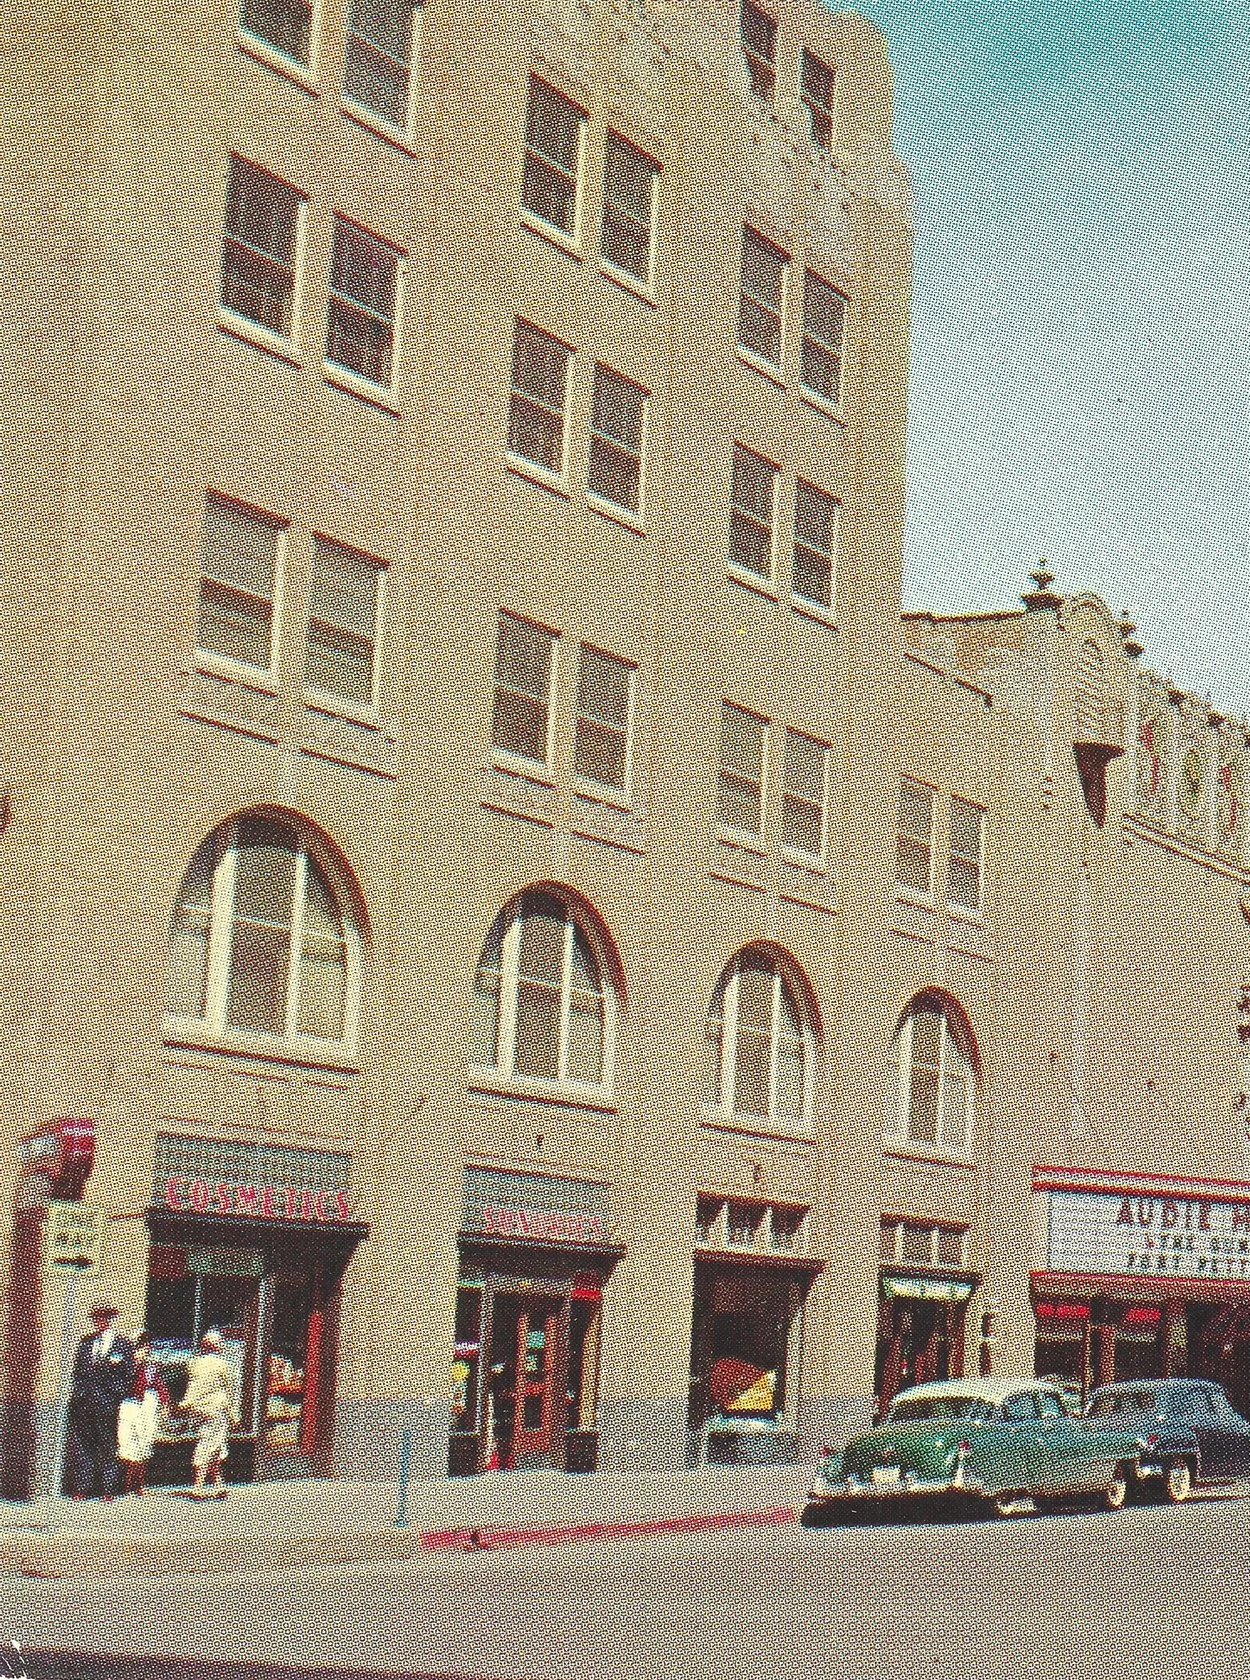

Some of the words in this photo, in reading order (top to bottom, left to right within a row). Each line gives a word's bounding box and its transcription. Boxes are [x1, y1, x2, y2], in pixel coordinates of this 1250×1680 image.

[165, 1174, 350, 1221] COSMETICS
[1116, 1197, 1212, 1231] AUDIE
[1159, 1233, 1195, 1251] THE
[1127, 1252, 1181, 1271] FORT
